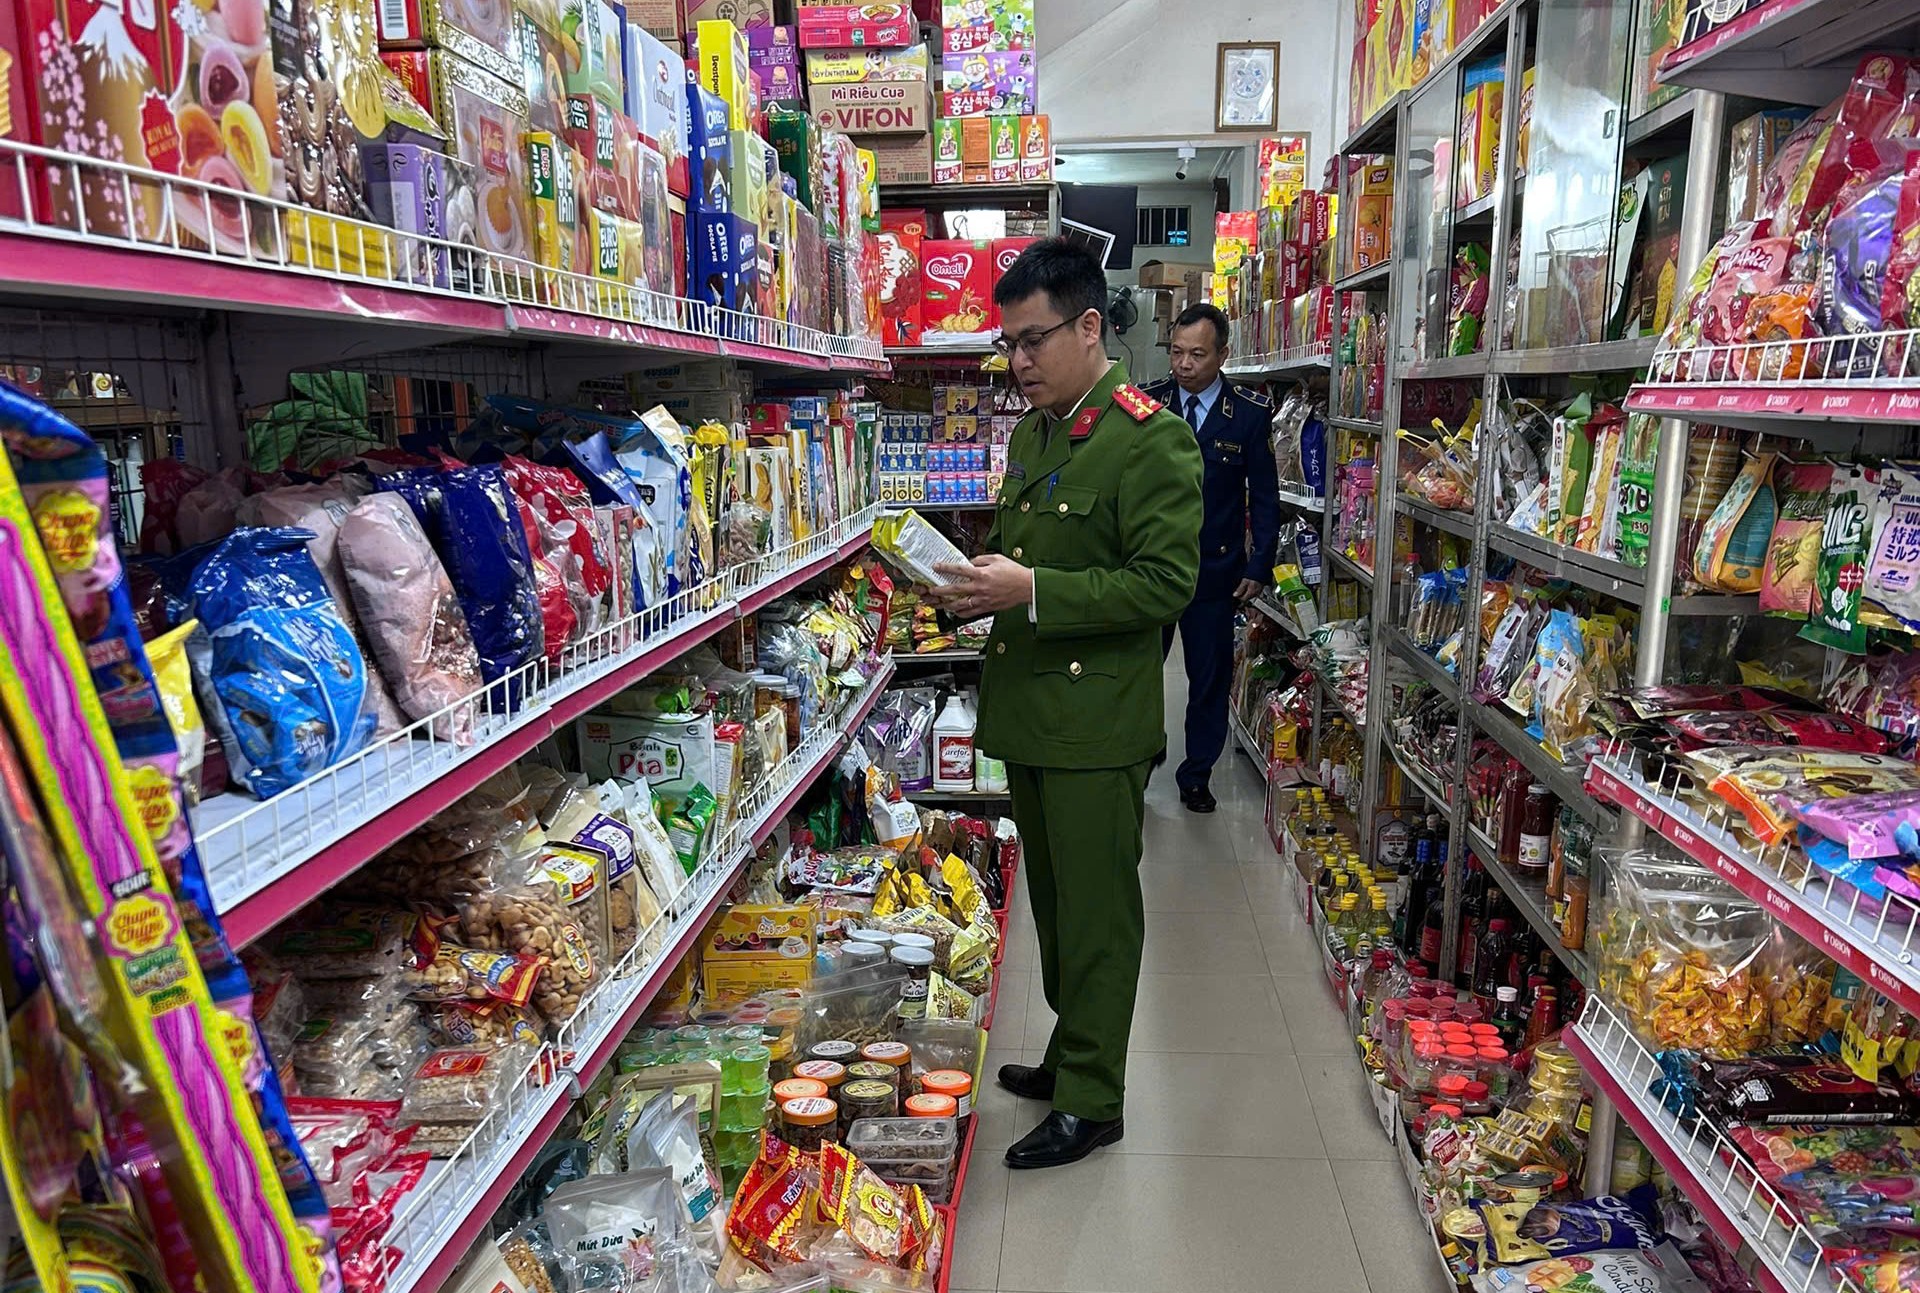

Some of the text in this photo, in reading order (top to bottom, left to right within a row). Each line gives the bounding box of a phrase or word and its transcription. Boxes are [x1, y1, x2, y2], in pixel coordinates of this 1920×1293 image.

[950, 32, 973, 51] 홍삼
[831, 86, 905, 100] Mì Riêu Cua
[836, 106, 914, 129] VIFON
[951, 97, 974, 116] 홍삼
[597, 116, 614, 139] EURO
[597, 137, 614, 160] CAKE
[600, 226, 618, 249] EURO
[715, 222, 729, 262] OREO
[600, 246, 618, 269] CAKE
[931, 262, 965, 276] Omeli
[1884, 546, 1920, 562] ミルク
[1723, 859, 1739, 879] ORION
[1771, 892, 1791, 913] ORION
[117, 906, 160, 929] Chupa
[1828, 936, 1850, 958] ORION
[1878, 969, 1901, 993] ORION
[1609, 1254, 1640, 1277] Milk
